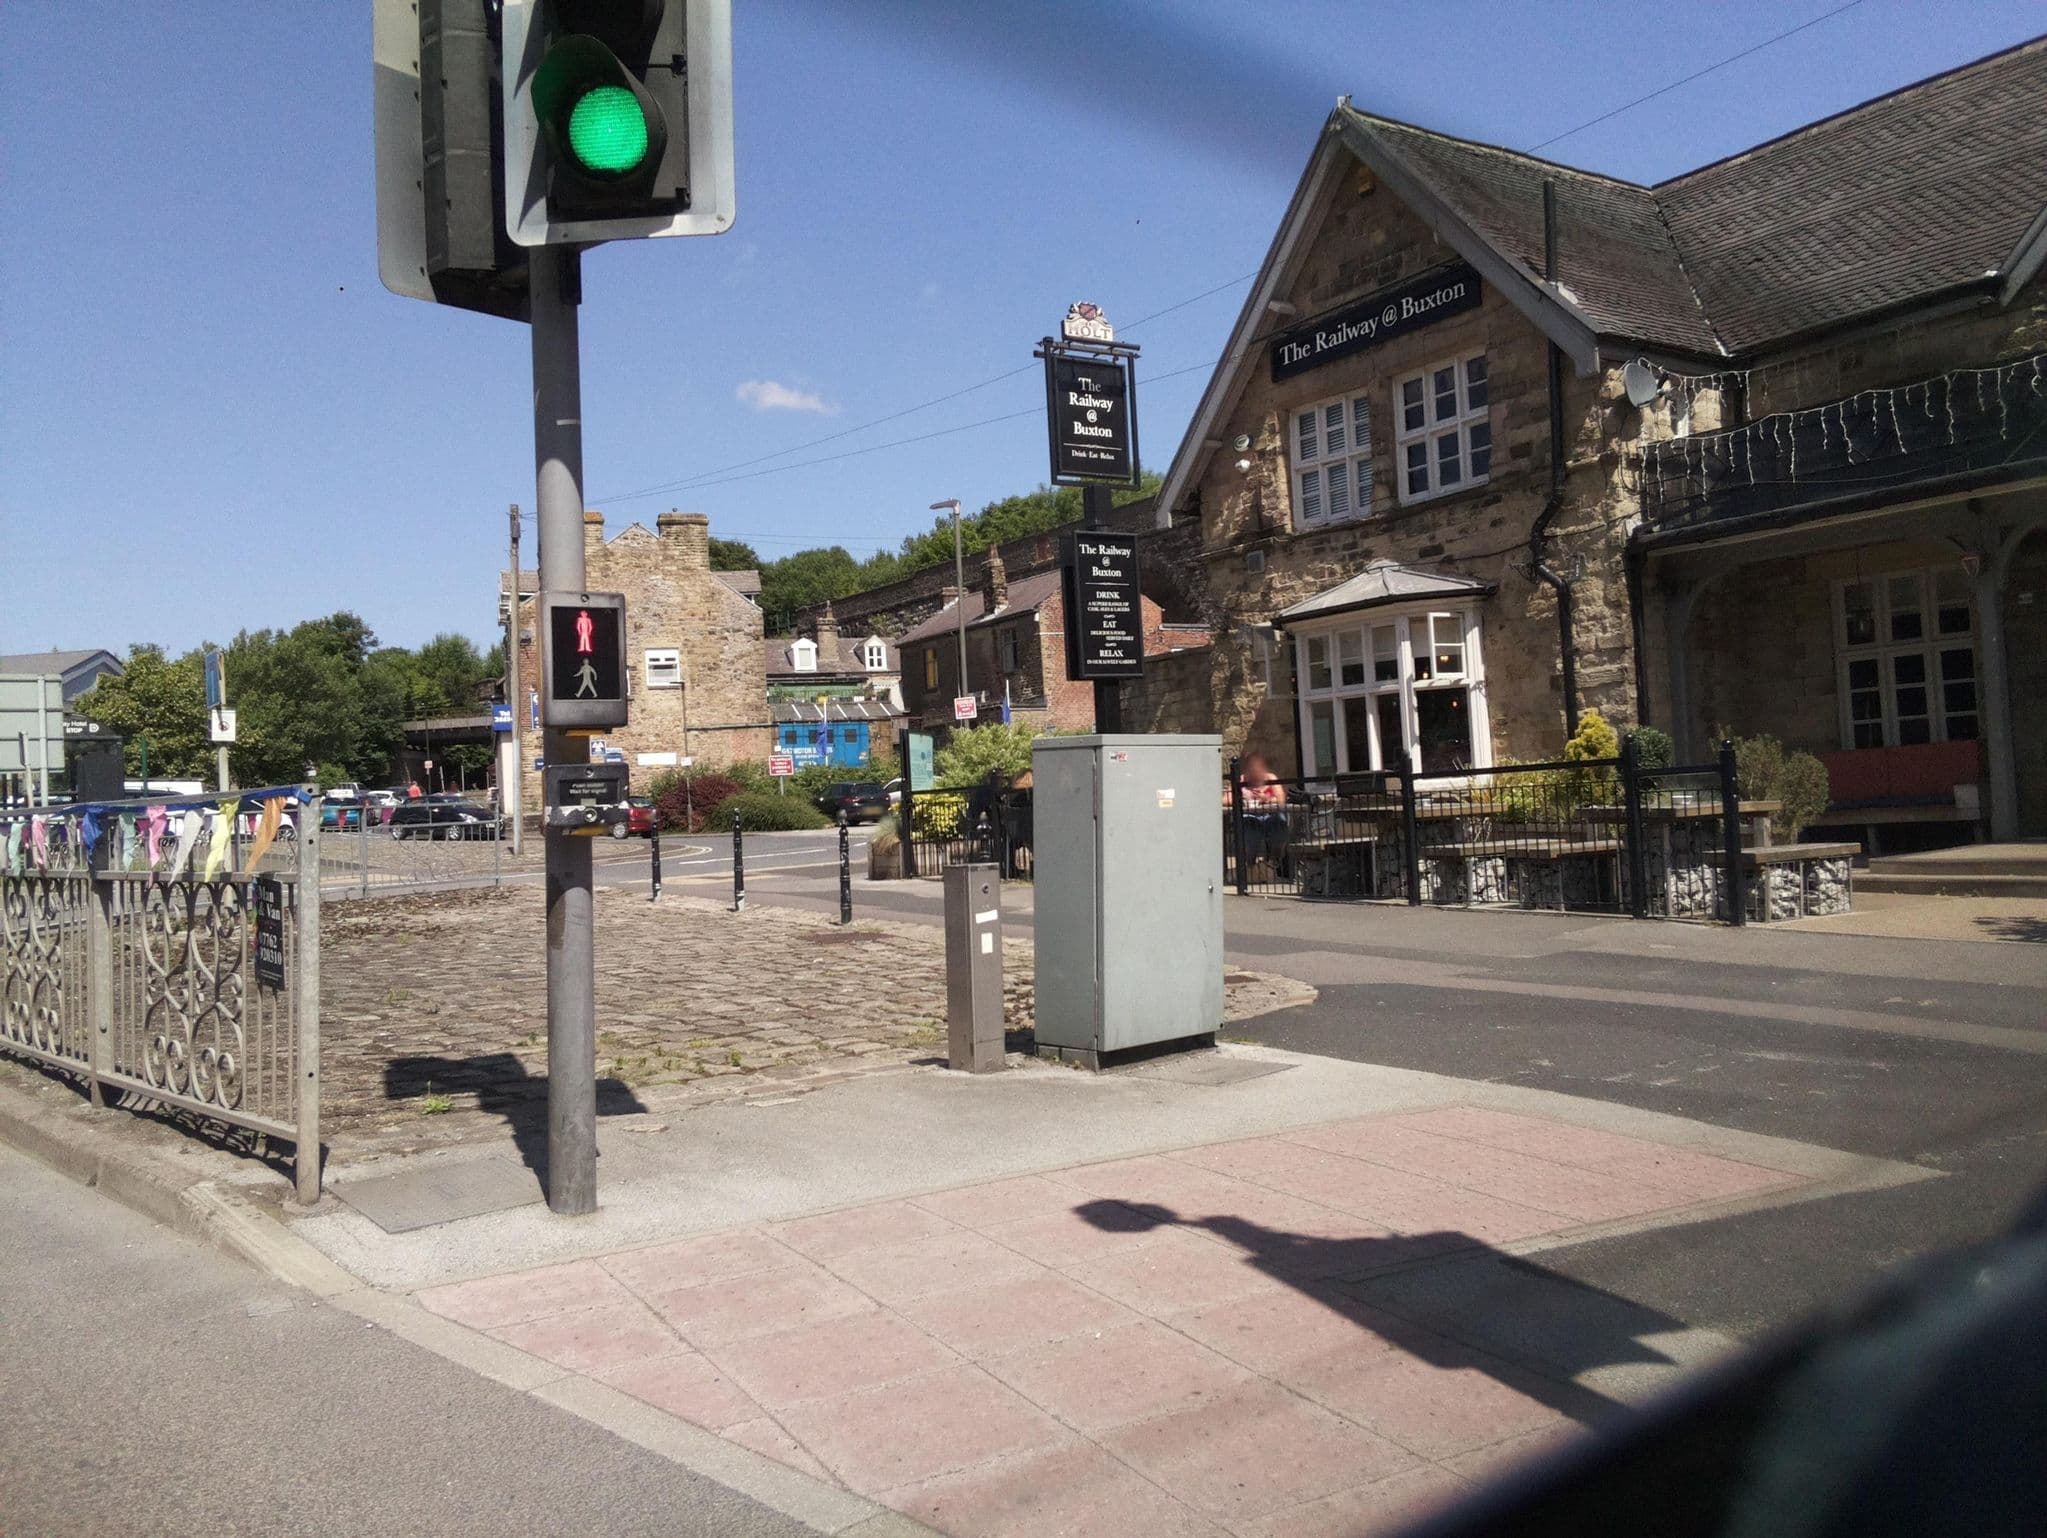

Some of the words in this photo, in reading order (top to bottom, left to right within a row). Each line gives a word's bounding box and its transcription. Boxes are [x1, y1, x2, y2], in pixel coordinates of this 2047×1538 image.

[1279, 342, 1311, 366] The
[1314, 322, 1380, 354] Railway
[1382, 304, 1398, 327] @
[1400, 282, 1466, 320] Buxton
[1068, 325, 1110, 340] HOLT
[1078, 377, 1102, 392] The
[1068, 392, 1114, 412] Railway
[1086, 410, 1098, 422] @
[1073, 421, 1112, 438] Buxton
[1072, 450, 1087, 458] Drink
[1078, 544, 1097, 554] The
[1098, 544, 1131, 558] Railway
[1102, 556, 1110, 567] @
[1092, 566, 1122, 577] Buxton
[266, 902, 280, 920] Van
